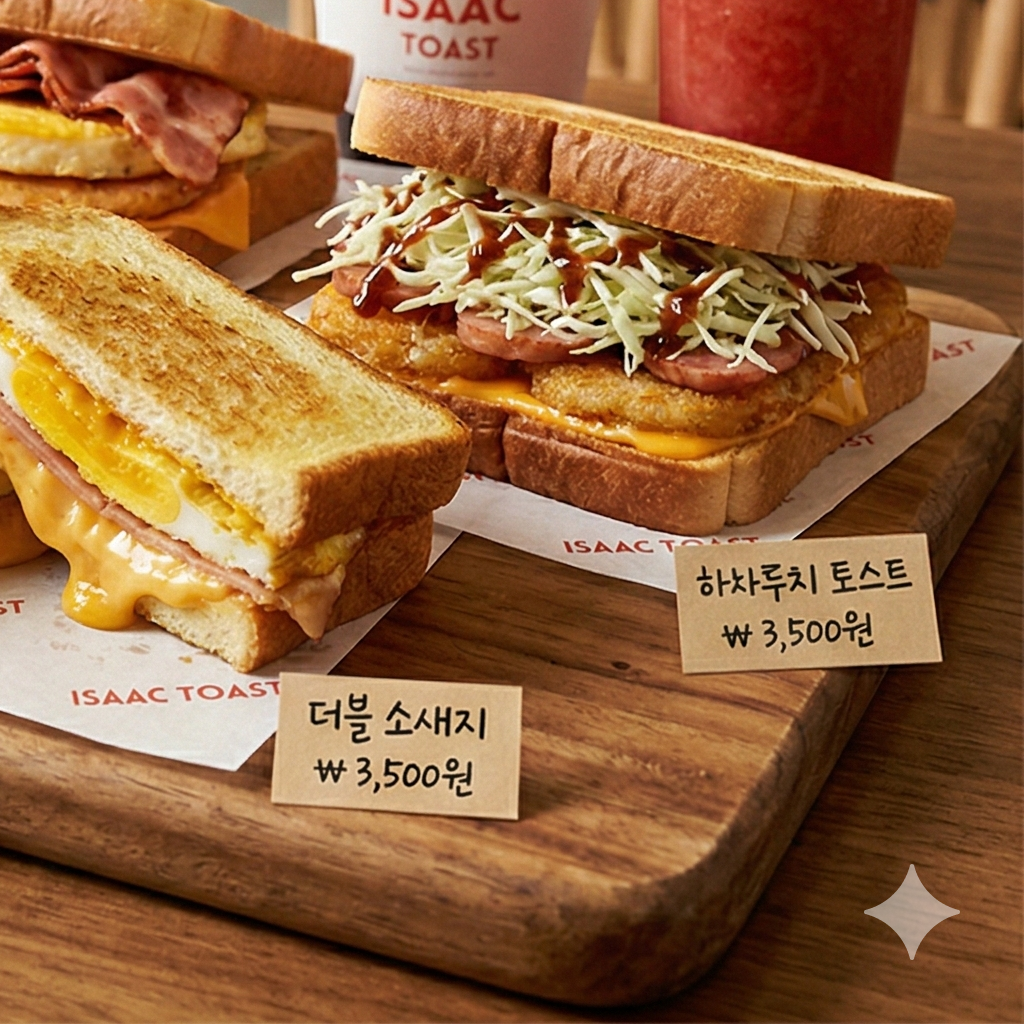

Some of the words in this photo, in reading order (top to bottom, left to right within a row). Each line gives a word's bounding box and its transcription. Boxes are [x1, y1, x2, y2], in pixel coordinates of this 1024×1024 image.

[401, 32, 500, 61] TOAST
[562, 538, 655, 555] ISAAC
[830, 558, 913, 595] 토스트
[761, 610, 874, 654] 3,500원
[70, 685, 170, 707] ISAAC
[175, 679, 280, 703] TOAST
[308, 692, 373, 744] 더블
[384, 699, 487, 741] 소새지
[356, 756, 474, 799] 3,500원
